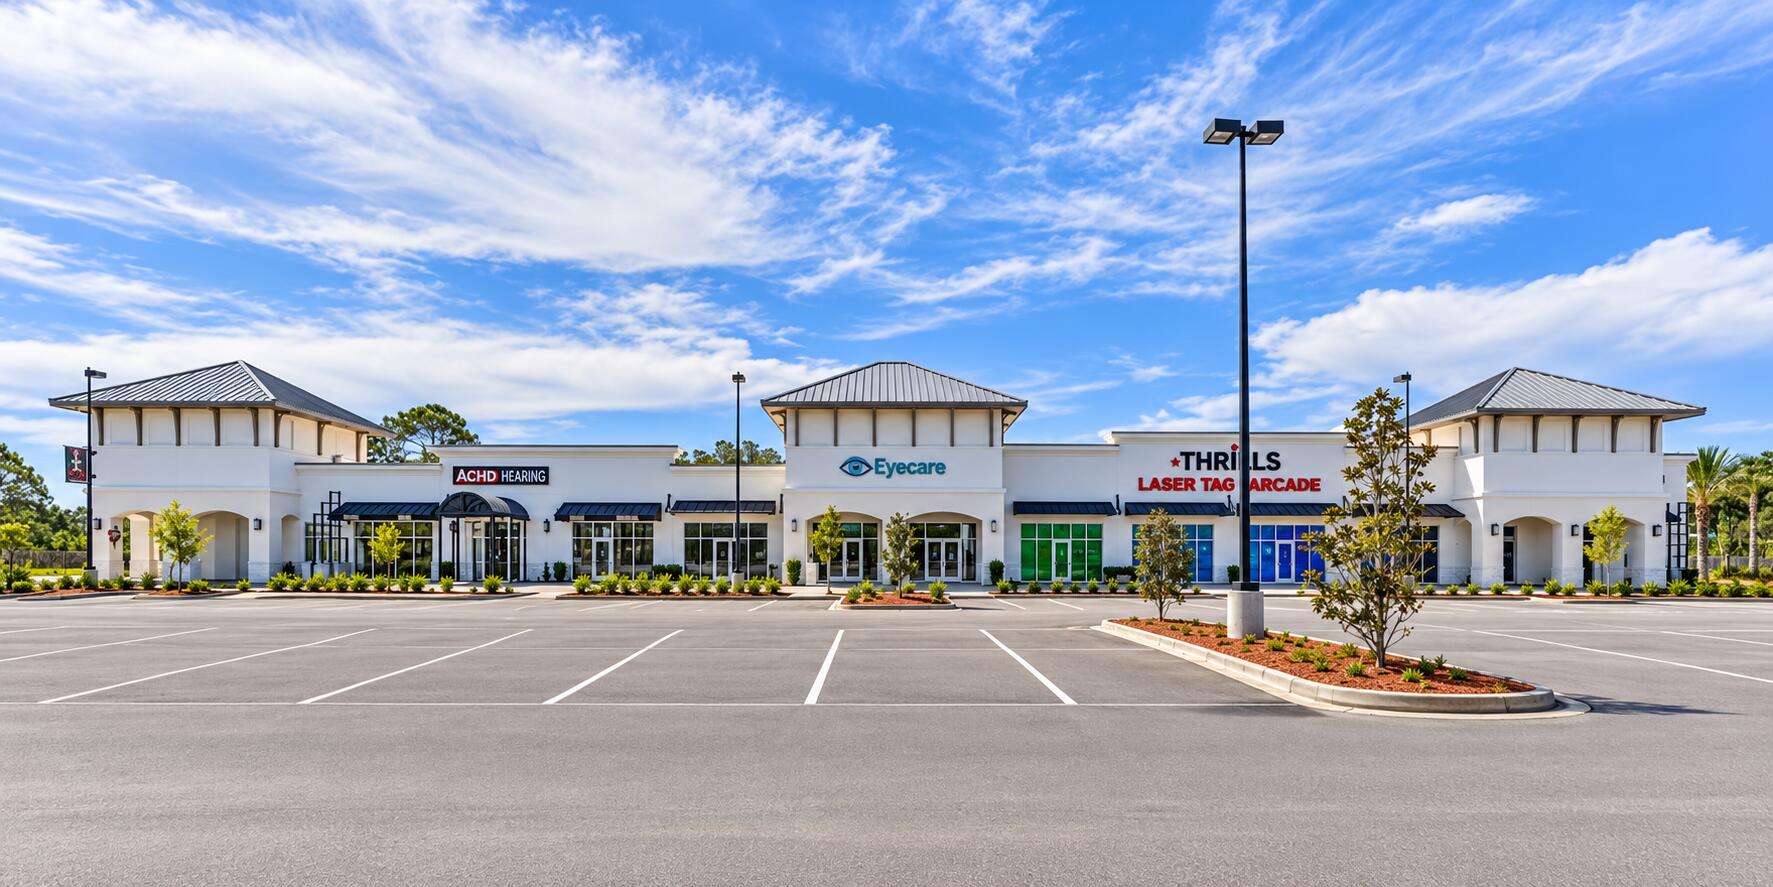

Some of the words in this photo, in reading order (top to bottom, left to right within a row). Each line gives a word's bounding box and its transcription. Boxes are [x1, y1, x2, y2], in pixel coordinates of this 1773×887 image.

[456, 469, 497, 482] ACHD
[501, 470, 546, 482] HEARING
[874, 458, 946, 479] Eyecare
[1138, 477, 1196, 491] LASER
[1201, 477, 1235, 491] TAG
[1249, 478, 1321, 491] ARCADE
